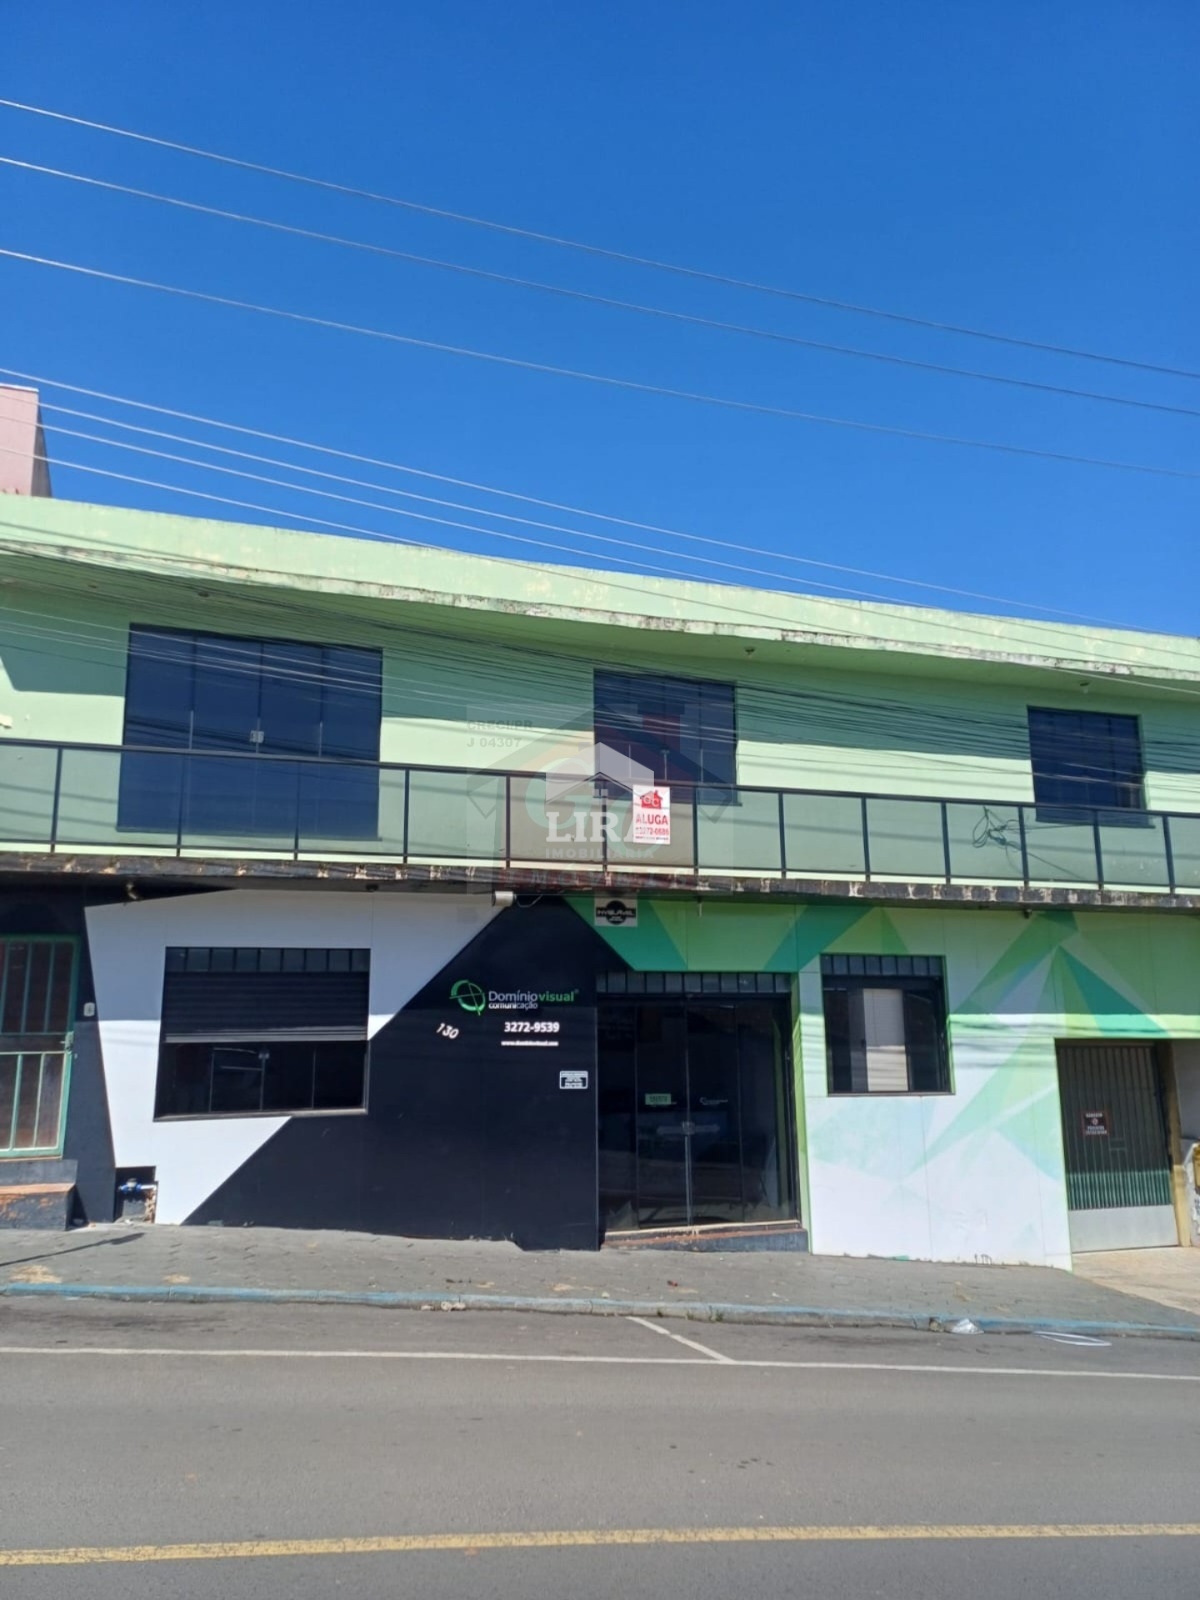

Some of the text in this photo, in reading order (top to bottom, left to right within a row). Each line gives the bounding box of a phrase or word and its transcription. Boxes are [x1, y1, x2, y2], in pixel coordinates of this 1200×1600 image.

[635, 814, 668, 825] ALUGA
[488, 1001, 538, 1011] comunicação
[436, 1022, 460, 1040] 130
[503, 1021, 560, 1033] 3272-9539
